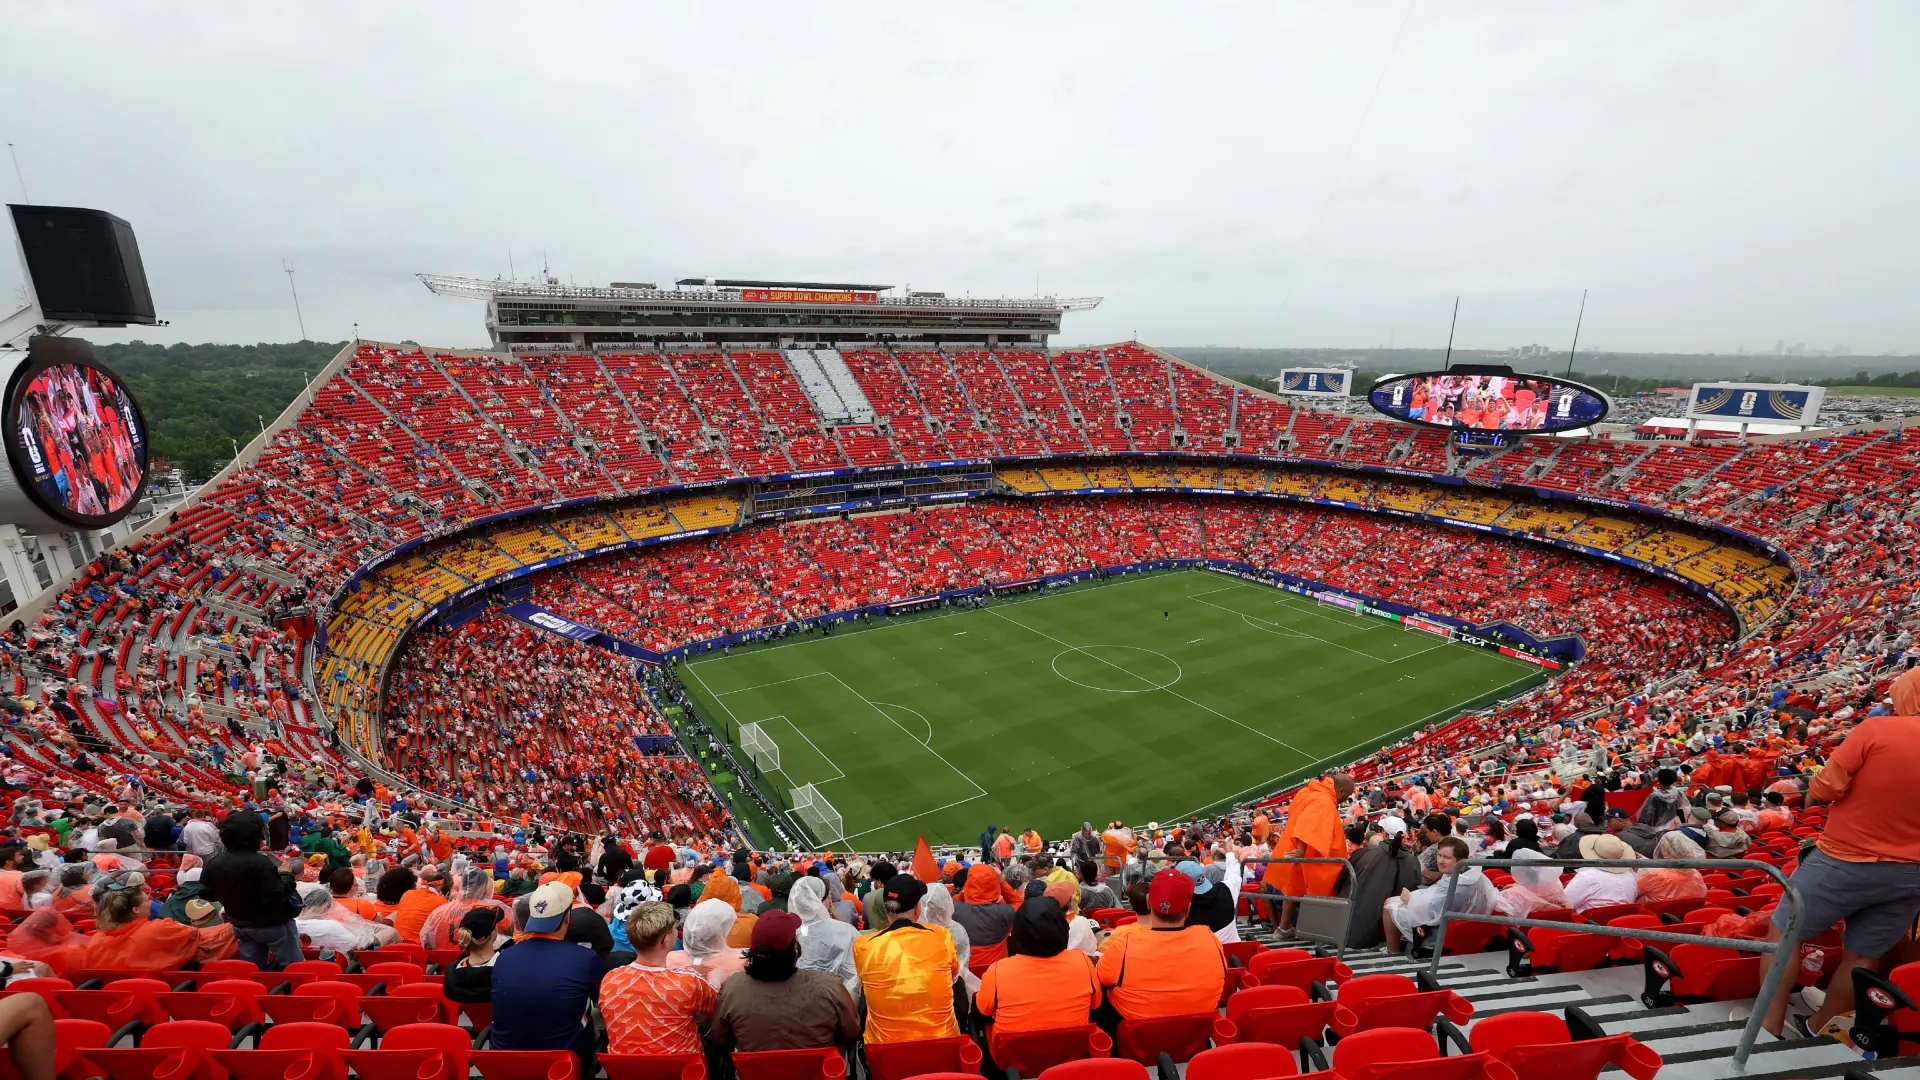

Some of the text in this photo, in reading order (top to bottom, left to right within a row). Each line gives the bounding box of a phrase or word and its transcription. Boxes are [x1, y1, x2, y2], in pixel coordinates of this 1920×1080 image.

[770, 291, 792, 300] SUPER
[794, 292, 812, 301] BOWL
[814, 292, 852, 302] CHAMPIONS
[1578, 496, 1610, 504] KANSAS
[1288, 585, 1300, 593] VISA
[1516, 652, 1541, 664] Lenovo
[1856, 1033, 1869, 1045] 40
